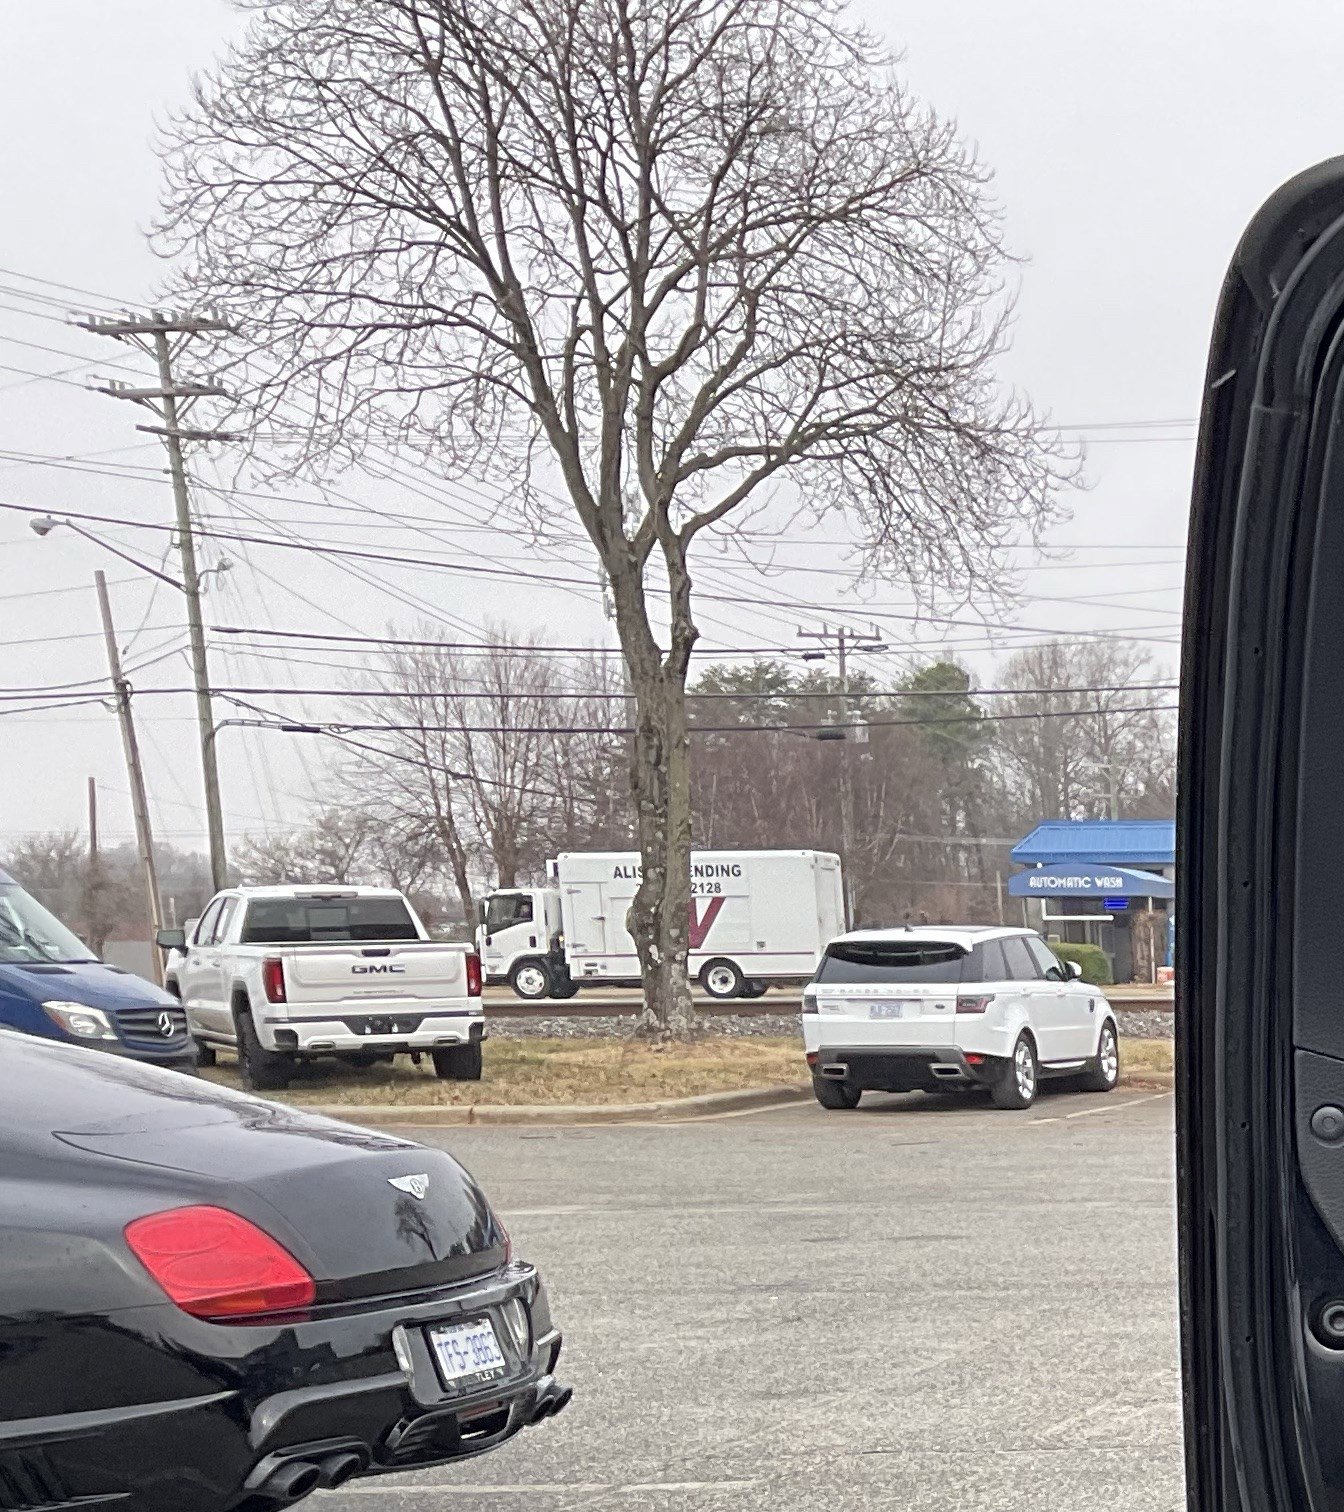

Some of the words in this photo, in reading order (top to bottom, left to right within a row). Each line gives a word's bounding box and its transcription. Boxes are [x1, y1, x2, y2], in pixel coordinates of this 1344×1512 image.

[690, 864, 742, 878] NDING
[1029, 876, 1091, 888] AUTOMATIC
[351, 964, 406, 974] GMC
